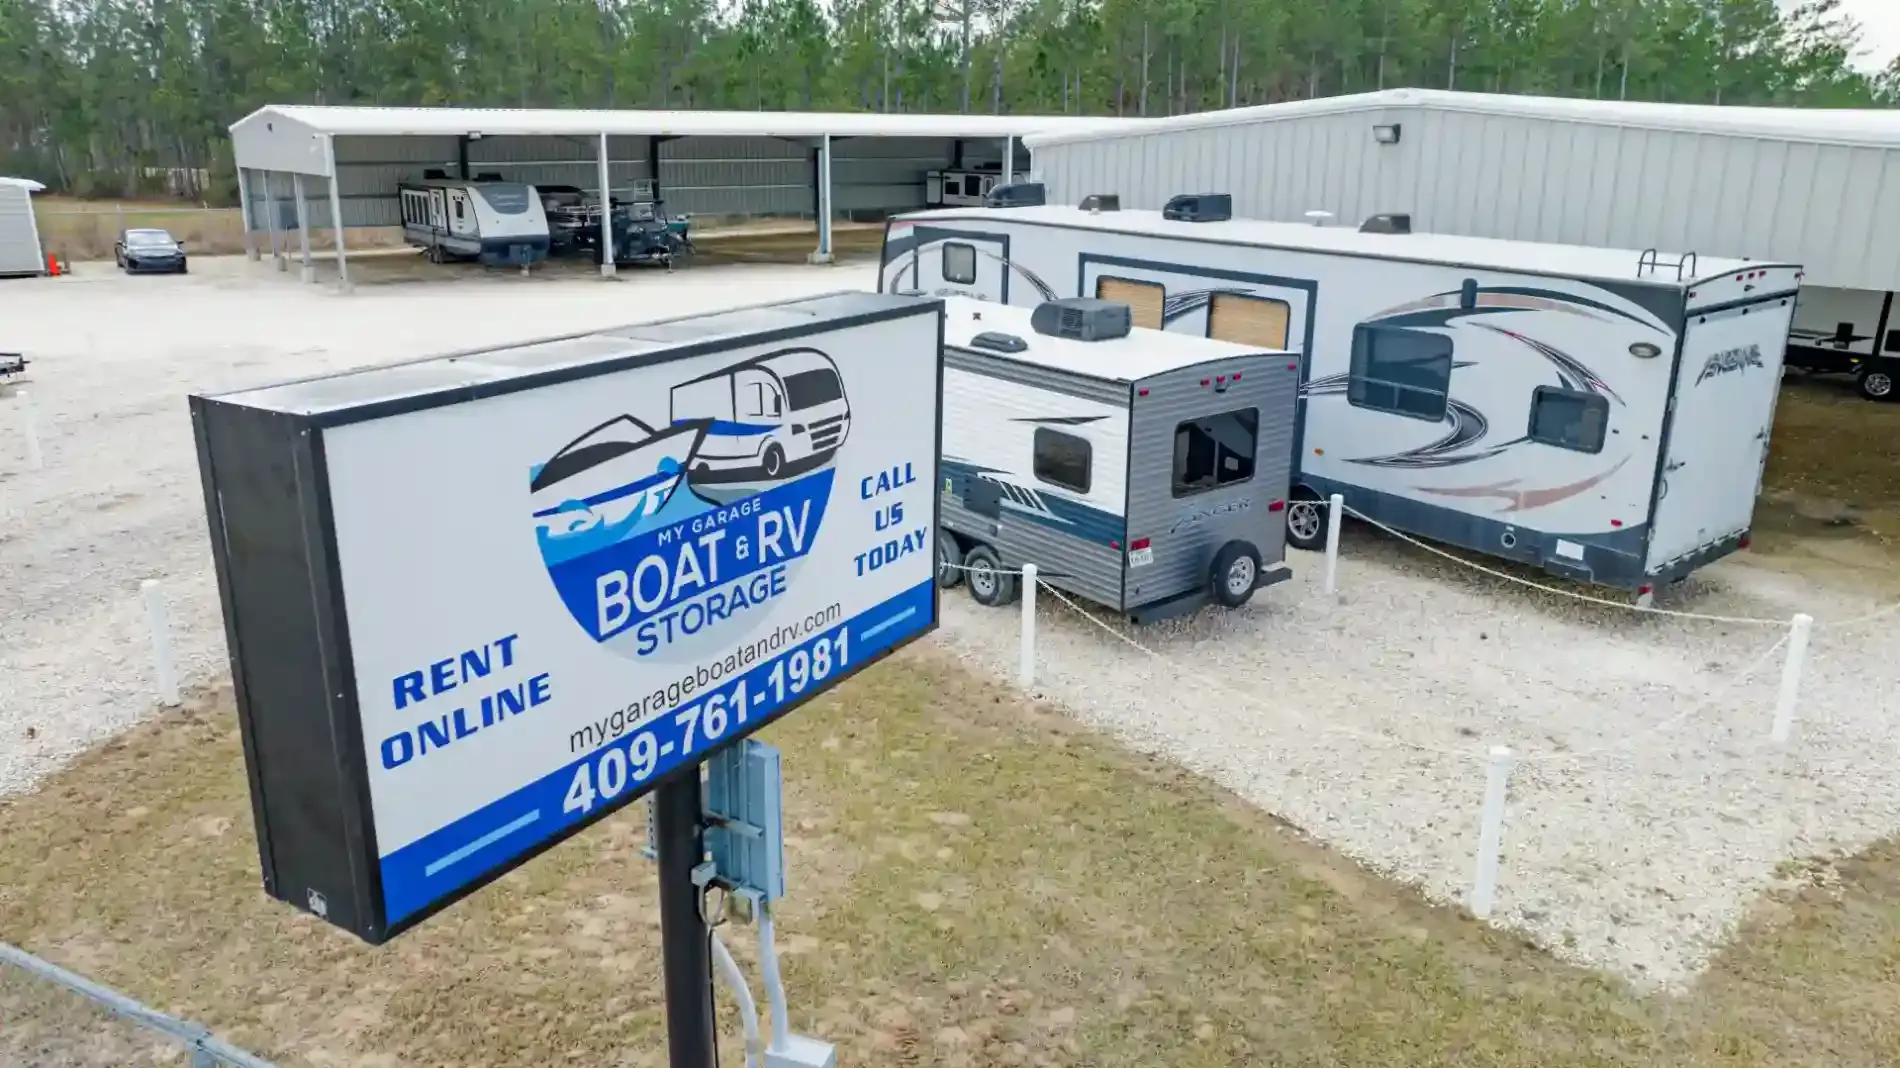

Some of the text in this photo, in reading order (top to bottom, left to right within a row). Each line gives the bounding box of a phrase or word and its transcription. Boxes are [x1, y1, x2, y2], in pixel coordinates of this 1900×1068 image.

[658, 498, 762, 547] MY GARAGE
[861, 462, 916, 500] CALL
[875, 501, 904, 532] US
[596, 499, 812, 636] BOAT & RV
[854, 526, 927, 577] TODAY
[637, 565, 787, 656] STORAGE
[392, 633, 519, 710] RENT
[569, 602, 842, 752] mygarageboatandrv.com
[380, 672, 552, 770] ONLINE
[563, 626, 849, 815] 409-761-1981
